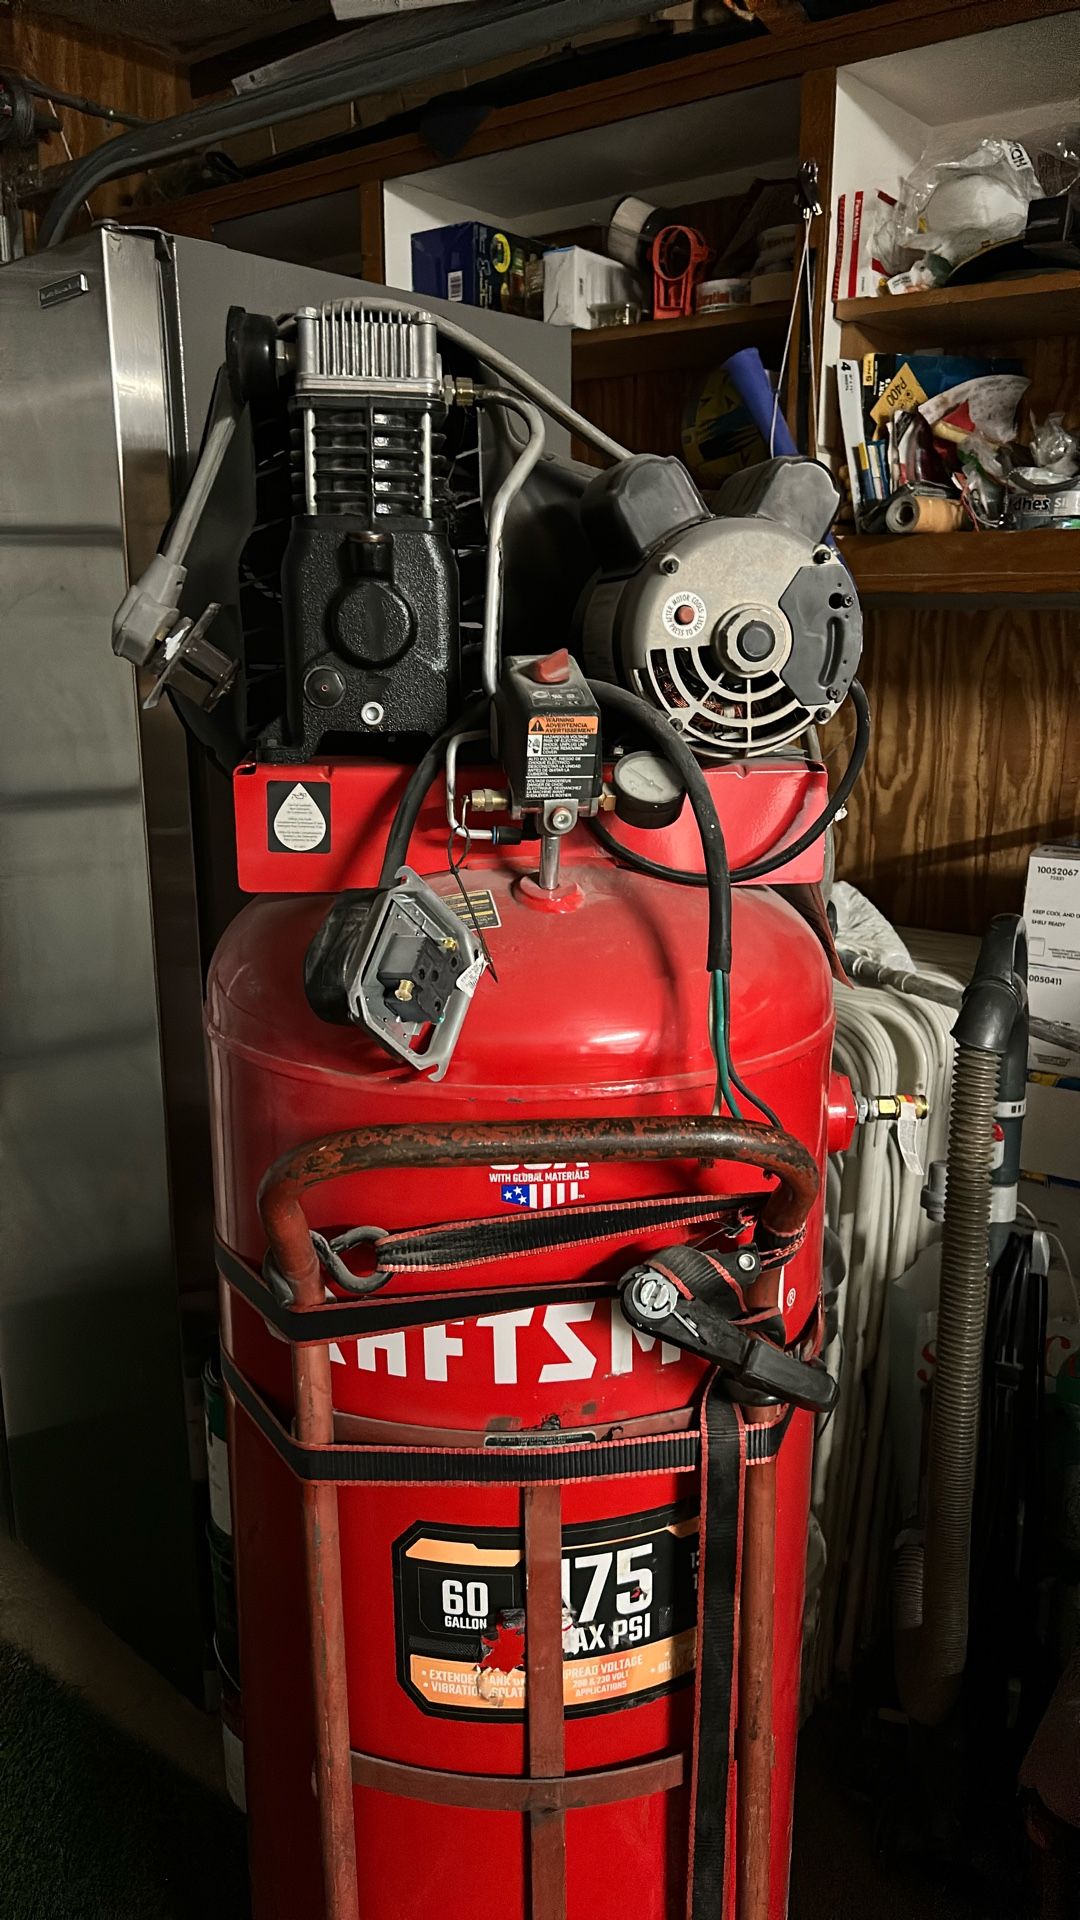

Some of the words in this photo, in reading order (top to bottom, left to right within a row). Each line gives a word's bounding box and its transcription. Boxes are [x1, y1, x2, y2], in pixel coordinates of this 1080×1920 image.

[1009, 145, 1028, 168] HD
[841, 362, 851, 371] 4
[886, 377, 907, 407] P400
[672, 594, 690, 606] MOTOR
[692, 597, 704, 613] COOLS
[1037, 865, 1079, 876] 10052067
[489, 1173, 511, 1183] WITH
[512, 1172, 544, 1182] GLOBAL
[545, 1170, 590, 1182] MATERIALS
[441, 1579, 488, 1617] 60
[444, 1615, 487, 1630] GALLON
[567, 1623, 606, 1652] AX
[611, 1612, 651, 1646] PSI
[600, 1654, 644, 1674] VOLTAGE
[431, 1681, 481, 1697] VIBRATIO
[575, 1680, 627, 1698] APPLICATIONS
